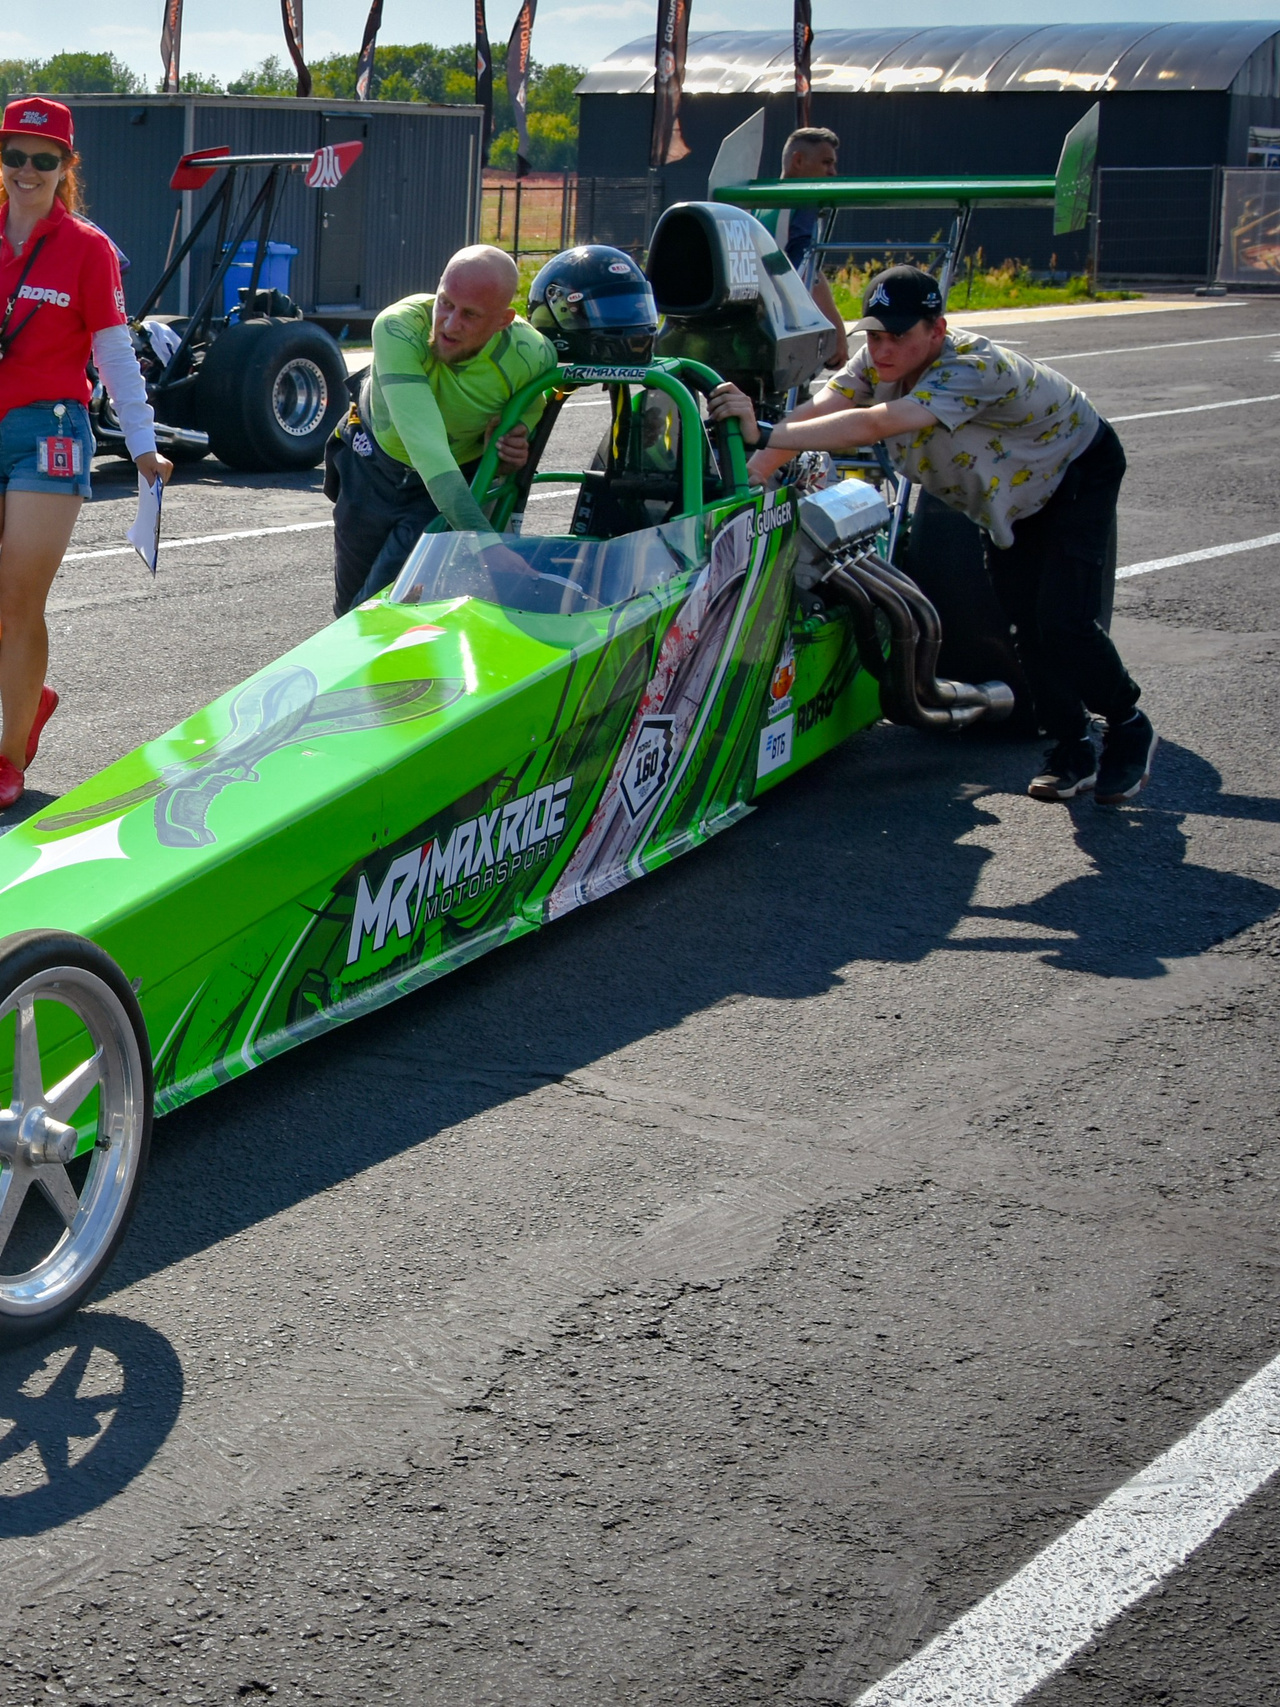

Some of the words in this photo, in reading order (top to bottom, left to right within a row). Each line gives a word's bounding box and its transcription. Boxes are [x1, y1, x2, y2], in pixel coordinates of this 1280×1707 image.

[723, 220, 756, 251] MAX
[728, 251, 759, 284] RIDE
[18, 285, 71, 308] RDRC
[757, 501, 792, 536] GUNGER
[771, 733, 786, 760] ВТБ
[633, 746, 660, 789] 160
[424, 834, 562, 923] MOTORSPORT
